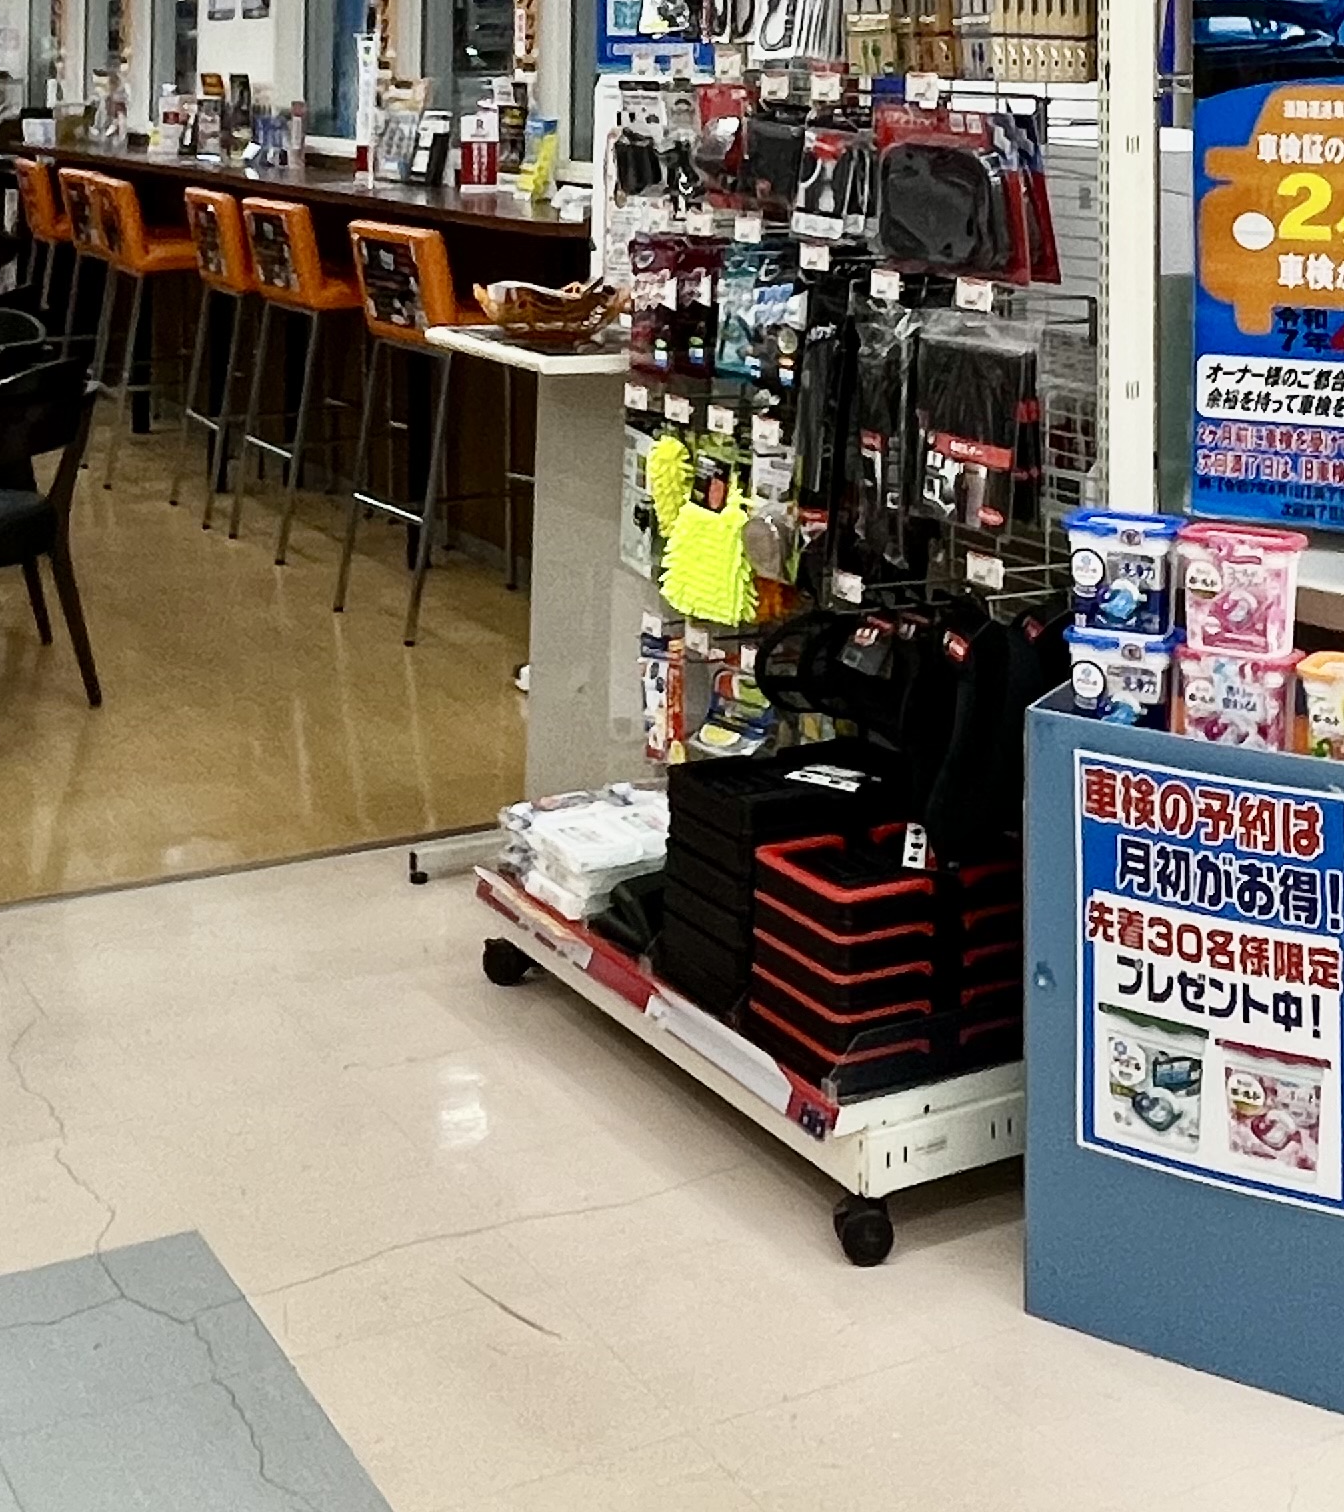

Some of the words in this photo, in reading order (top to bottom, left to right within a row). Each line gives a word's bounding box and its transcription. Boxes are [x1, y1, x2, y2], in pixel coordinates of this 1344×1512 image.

[1083, 767, 1324, 858] 車検の予約は
[1117, 837, 1344, 932] 月初がお得!
[1086, 900, 1343, 993] 先着30名様限定
[1116, 954, 1322, 1039] プレゼント中!
